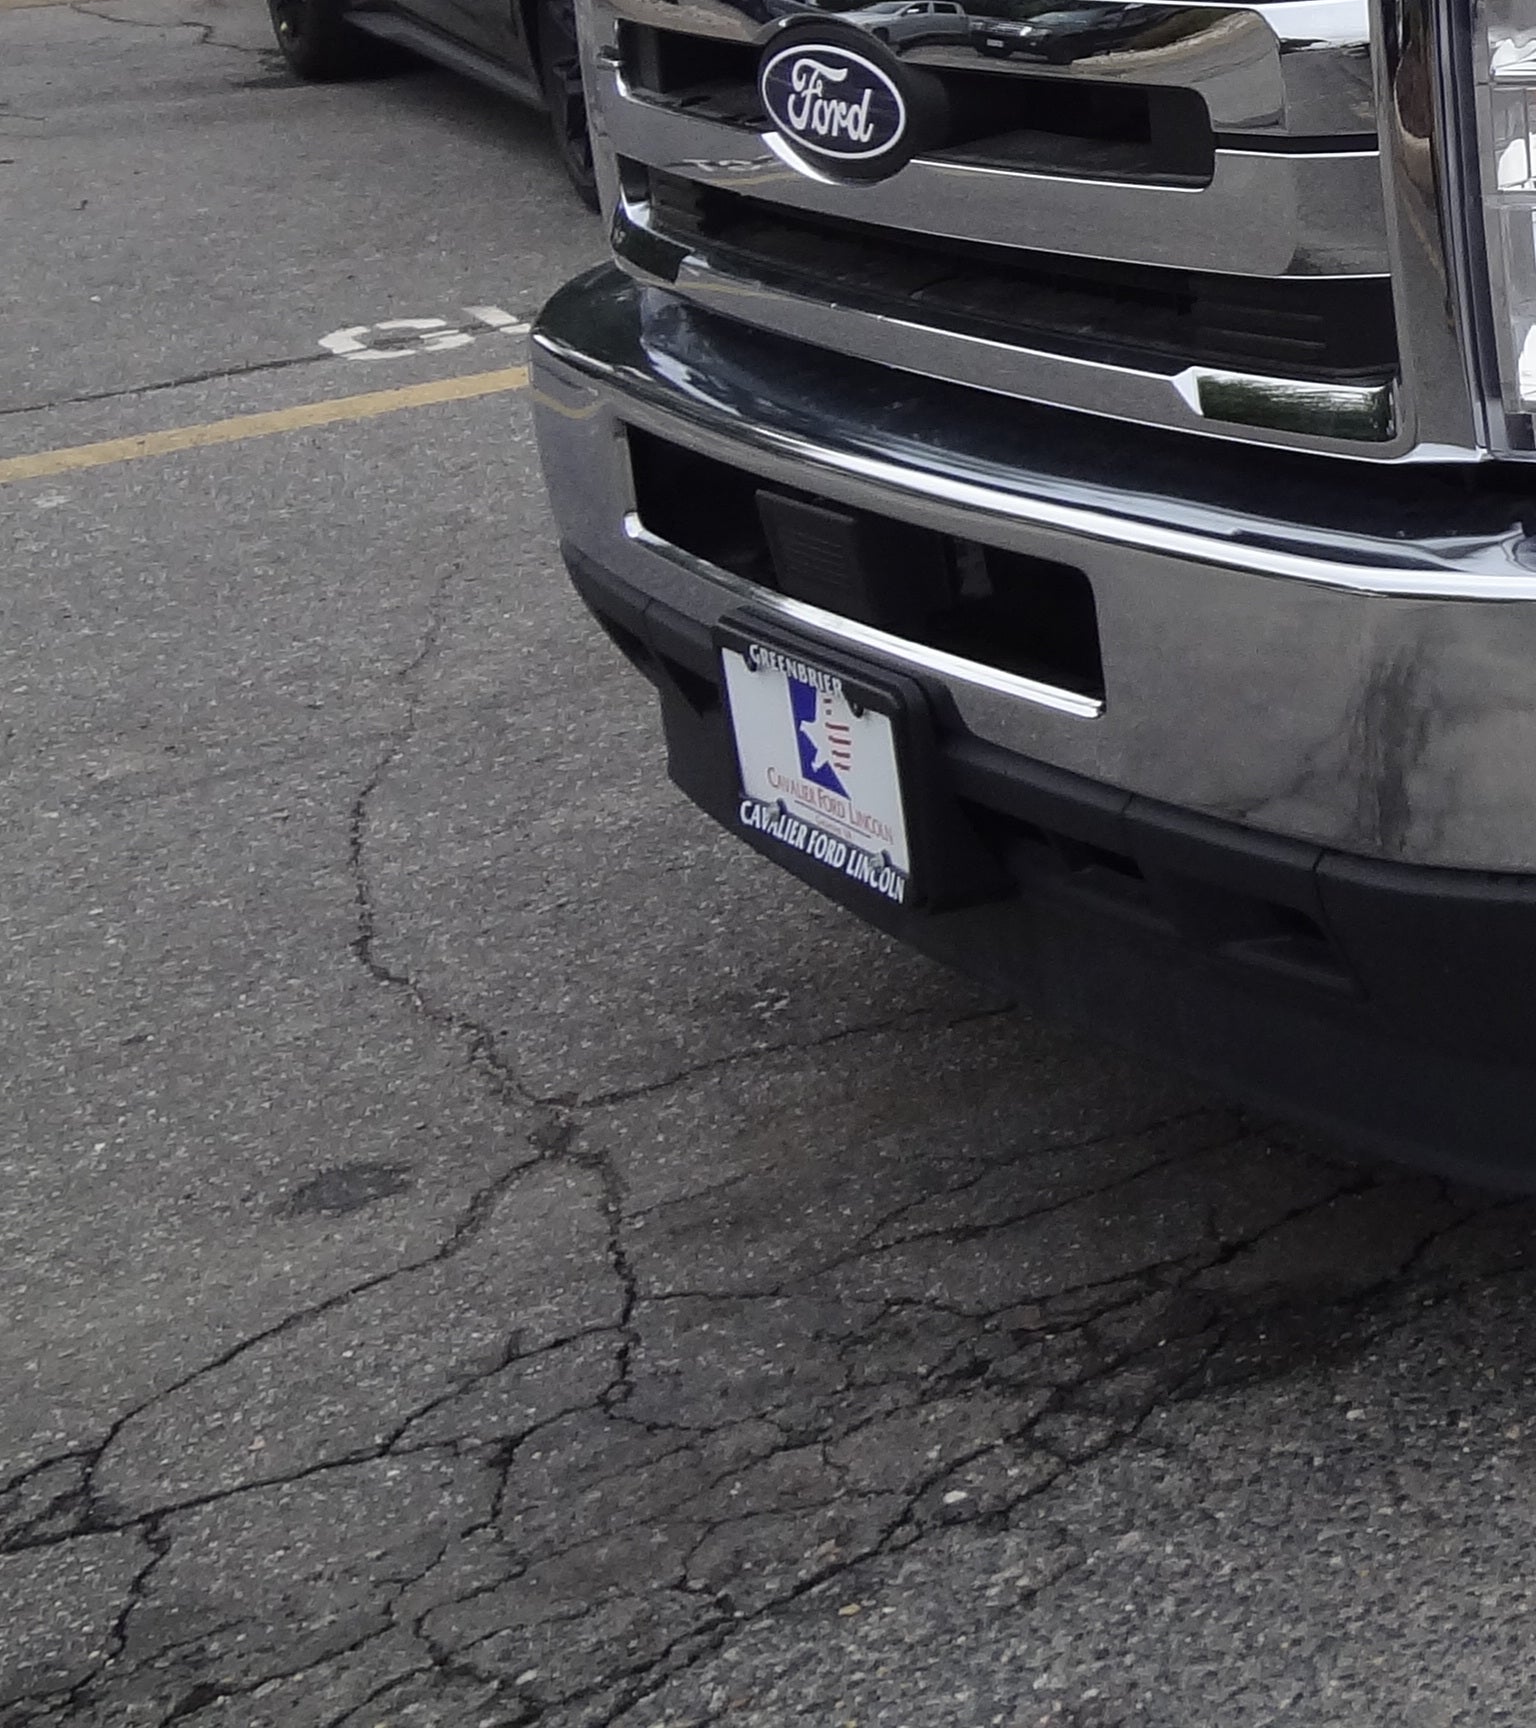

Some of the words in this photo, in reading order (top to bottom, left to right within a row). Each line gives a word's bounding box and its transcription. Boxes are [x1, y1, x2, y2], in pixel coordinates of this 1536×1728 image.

[788, 58, 874, 142] Ford
[749, 644, 842, 696] GREENBRIER
[817, 788, 846, 819] FORD
[806, 830, 847, 868] FORD
[846, 850, 905, 904] LINCOLN
